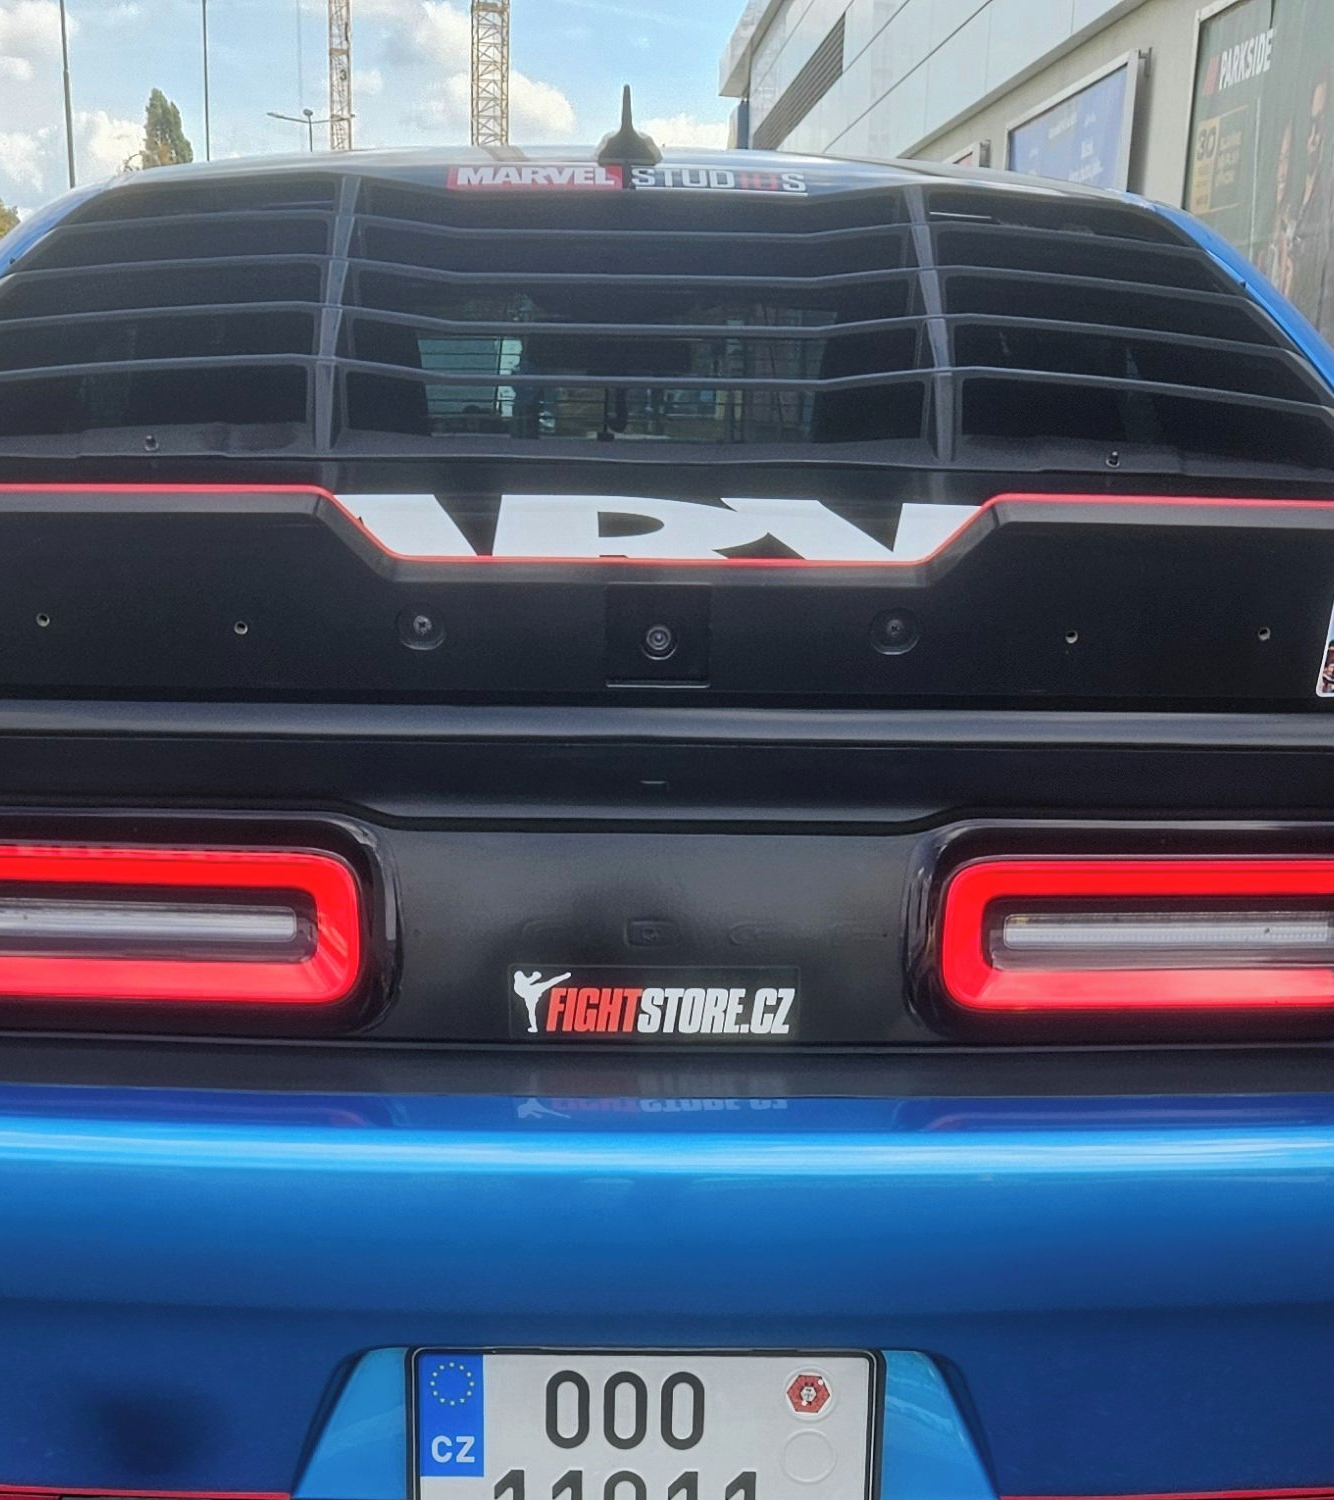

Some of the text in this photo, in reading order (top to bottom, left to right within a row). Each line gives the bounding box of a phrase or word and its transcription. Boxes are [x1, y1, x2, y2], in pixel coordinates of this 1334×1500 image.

[1219, 27, 1276, 90] PARKSIDE
[457, 167, 615, 185] MARVEL
[545, 987, 796, 1034] FIGHTSTORE.CZ
[546, 1370, 705, 1450] 000
[431, 1435, 476, 1463] CZ
